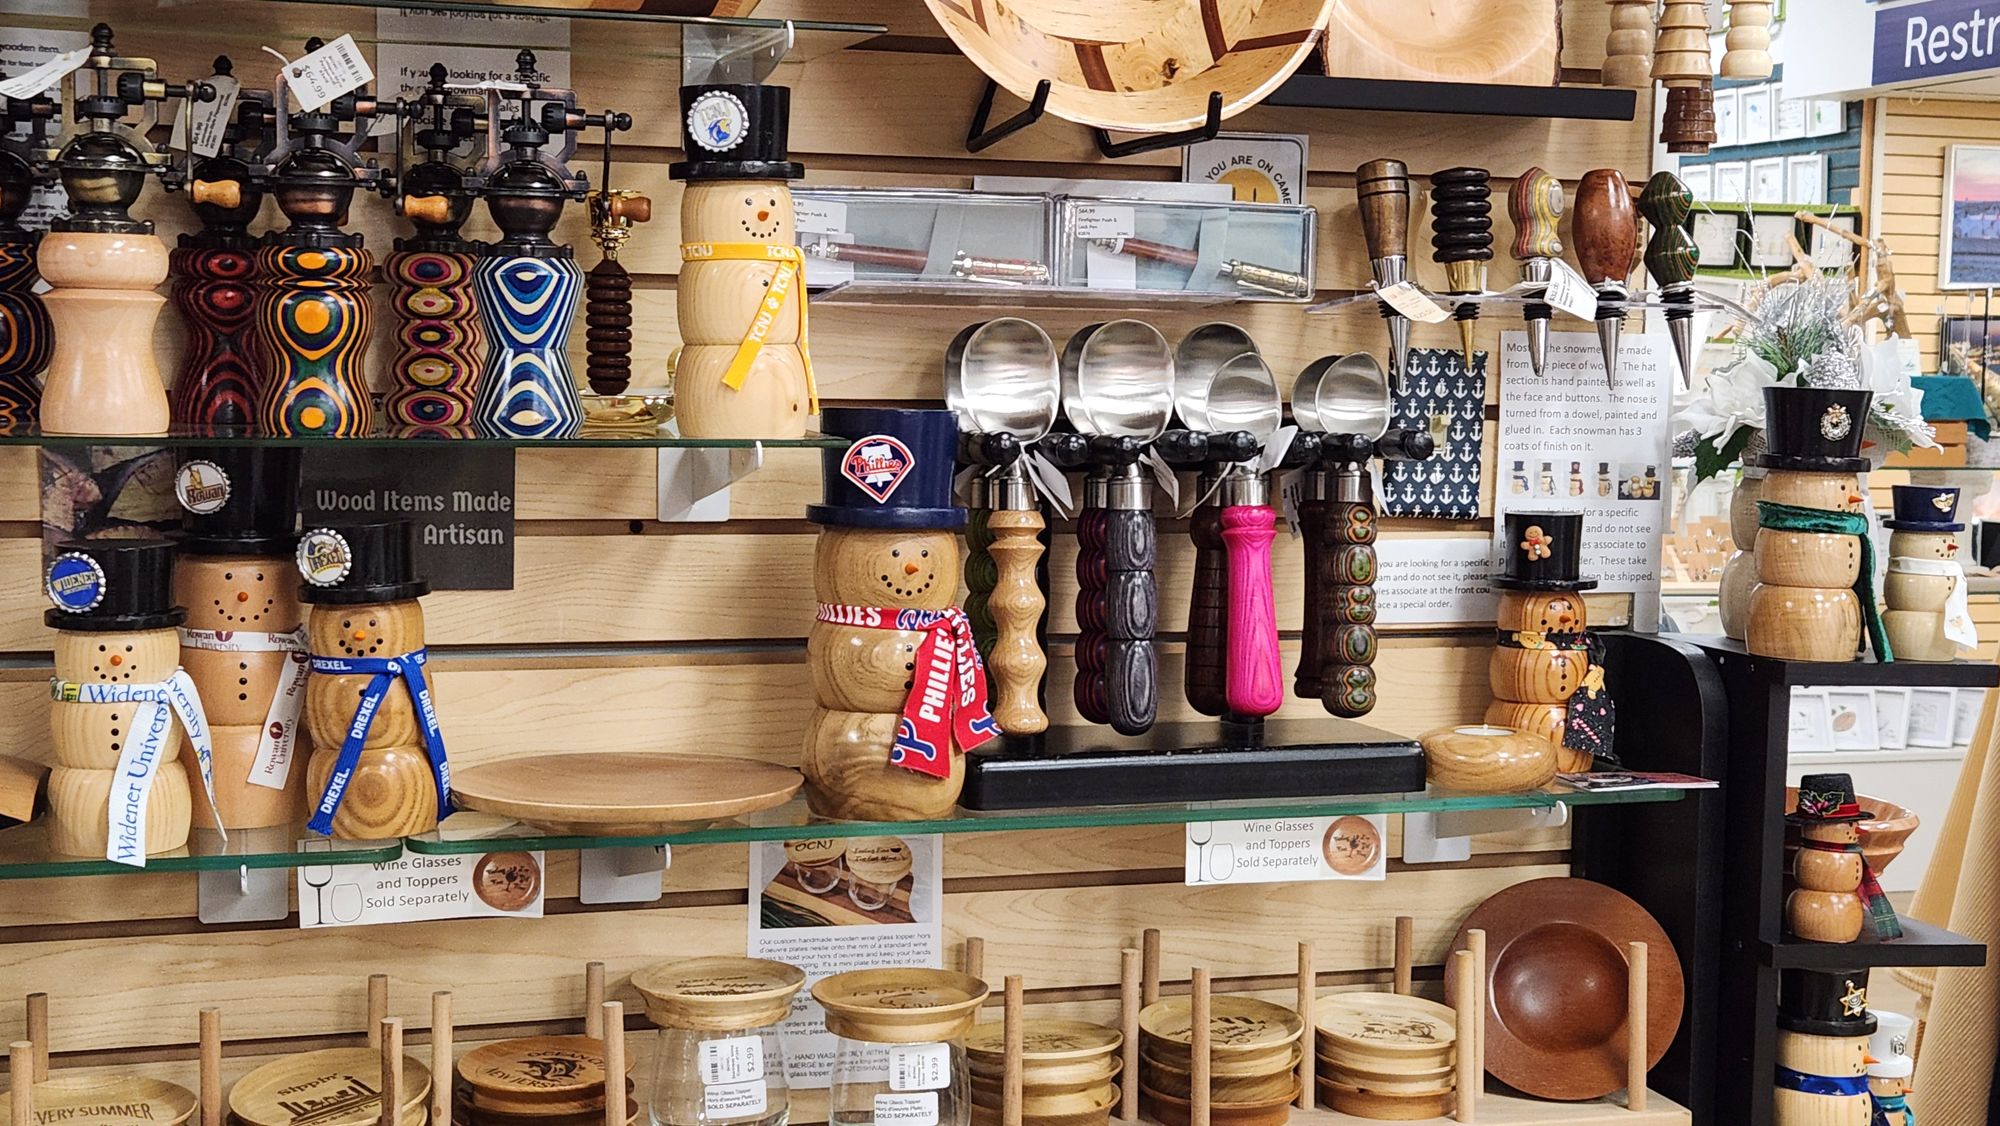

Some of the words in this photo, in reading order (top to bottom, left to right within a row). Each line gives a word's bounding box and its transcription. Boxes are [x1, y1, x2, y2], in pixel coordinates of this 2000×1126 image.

[450, 69, 486, 81] looking
[489, 71, 503, 81] for
[1205, 161, 1227, 181] YOU
[1231, 155, 1253, 167] ARE
[1257, 159, 1274, 174] ON
[687, 245, 713, 257] TCNJ
[749, 314, 773, 342] TCNJ
[772, 266, 794, 294] TCNJ
[1627, 346, 1652, 355] made
[1506, 359, 1529, 368] from
[1551, 362, 1576, 370] piece
[1579, 360, 1588, 369] of
[1623, 362, 1639, 371] The
[1641, 363, 1656, 371] hat
[1506, 377, 1539, 385] section
[1541, 377, 1548, 385] is
[1551, 377, 1574, 386] hand
[1577, 378, 1610, 388] painted
[1626, 379, 1643, 387] well
[1524, 393, 1543, 401] face
[1546, 394, 1562, 402] and
[1565, 394, 1601, 402] buttons.
[1608, 394, 1624, 403] The
[1650, 395, 1657, 403] is
[1540, 409, 1561, 418] from
[1572, 410, 1602, 420] dowel,
[1605, 411, 1638, 420] painted
[1641, 411, 1657, 419] and
[1505, 425, 1530, 435] glued
[1533, 426, 1544, 434] in.
[1550, 426, 1570, 434] Each
[1573, 426, 1616, 435] snowman
[1619, 427, 1634, 435] has
[1636, 427, 1642, 435] 3
[1505, 442, 1529, 450] coats
[1532, 441, 1542, 450] of
[1543, 442, 1567, 451] finish
[1584, 443, 1593, 451] it.
[851, 455, 903, 476] Phillies
[187, 486, 225, 504] Rowan
[317, 490, 376, 511] Wood
[384, 490, 445, 512] Items
[452, 490, 511, 512] Made
[1584, 508, 1596, 516] for
[1605, 508, 1638, 518] specific
[423, 523, 504, 545] Artisan
[1593, 541, 1634, 549] associate
[1410, 560, 1438, 568] looking
[1461, 558, 1489, 568] specific
[1462, 572, 1488, 581] please
[1604, 572, 1615, 580] be
[1618, 572, 1655, 583] shipped.
[1454, 586, 1474, 594] front
[1400, 600, 1426, 610] special
[187, 629, 215, 640] Rowan
[264, 740, 281, 775] Rowan
[117, 783, 143, 861] Widener
[1243, 823, 1271, 833] Wine
[1275, 821, 1314, 831] Glasses
[795, 840, 833, 852] OCNJ
[1246, 840, 1267, 850] and
[1270, 840, 1311, 851] Toppers
[373, 859, 408, 872] Wine
[412, 856, 461, 869] Glasses
[1236, 856, 1260, 868] Sold
[1263, 855, 1318, 869] Separately
[376, 878, 401, 889] and
[407, 875, 459, 889] Toppers
[366, 896, 395, 908] Sold
[399, 891, 469, 907] Separately
[746, 1047, 754, 1072] $2.99
[34, 1109, 76, 1126] VERY
[79, 1103, 155, 1120] SUMMER
